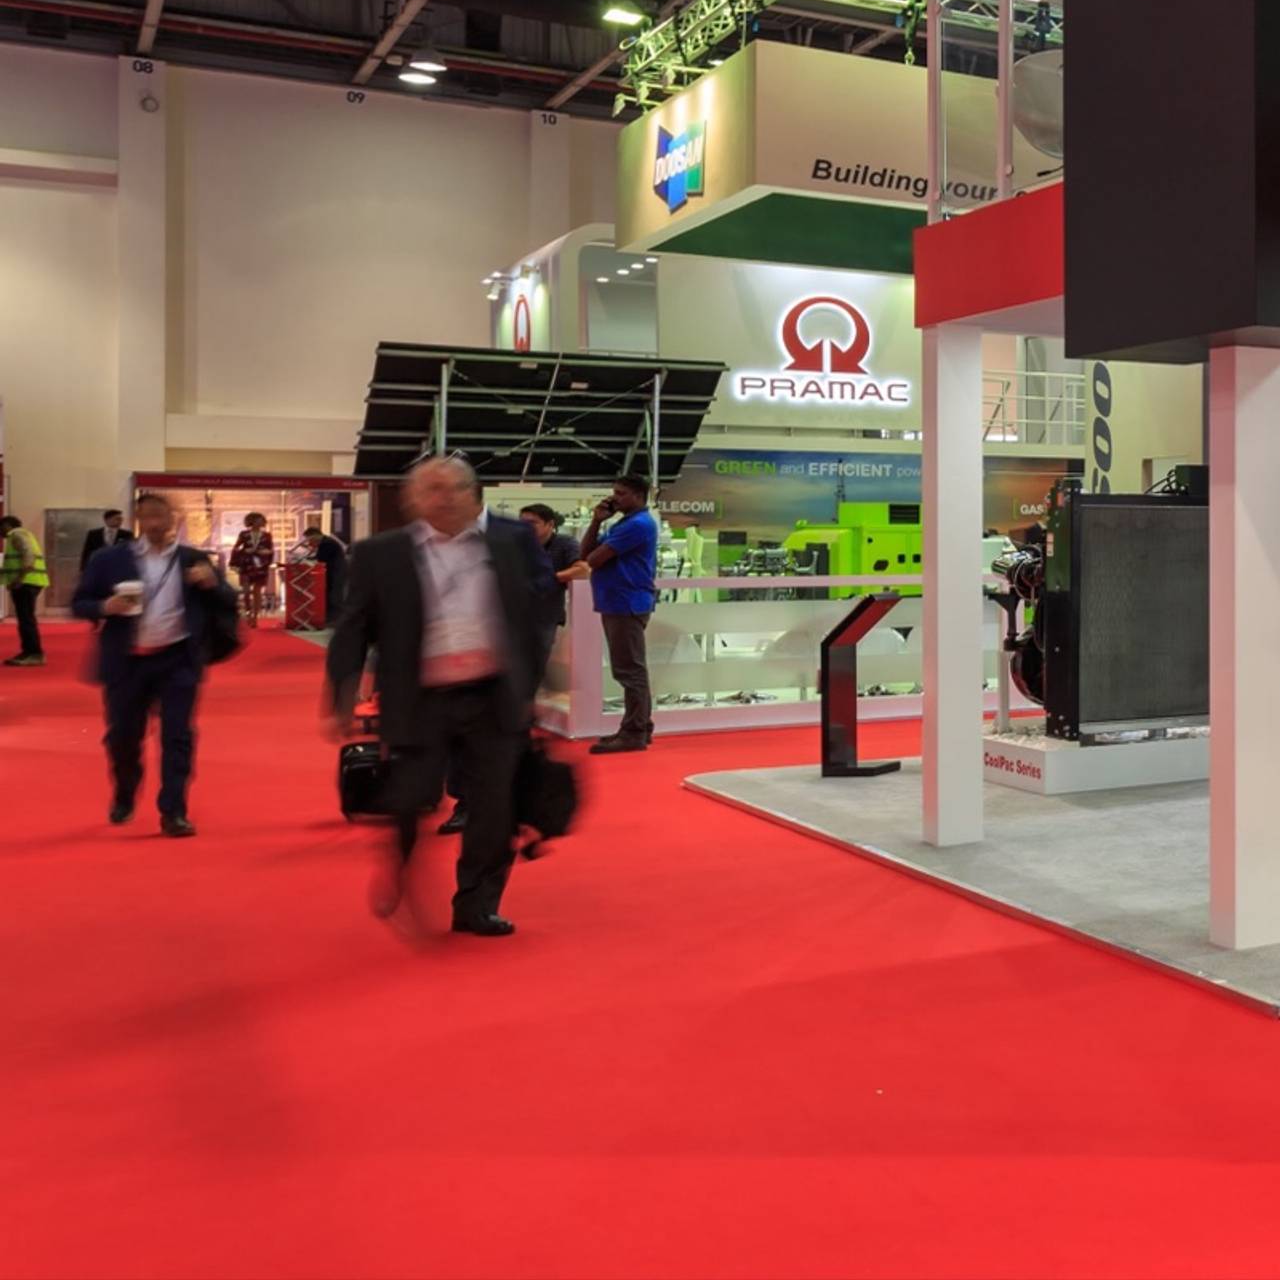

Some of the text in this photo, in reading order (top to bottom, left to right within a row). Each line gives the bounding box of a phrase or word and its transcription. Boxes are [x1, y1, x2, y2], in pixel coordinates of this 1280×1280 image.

[132, 60, 153, 74] 08
[346, 91, 365, 104] 09
[541, 114, 557, 125] 10
[654, 132, 704, 186] DOOSAN
[811, 159, 928, 198] Building
[740, 376, 908, 402] PRAMAC
[714, 459, 776, 475] GREEN
[779, 462, 805, 476] and
[807, 461, 893, 478] EFFICIENT
[655, 500, 715, 513] ELECOM
[1016, 759, 1041, 780] Series
